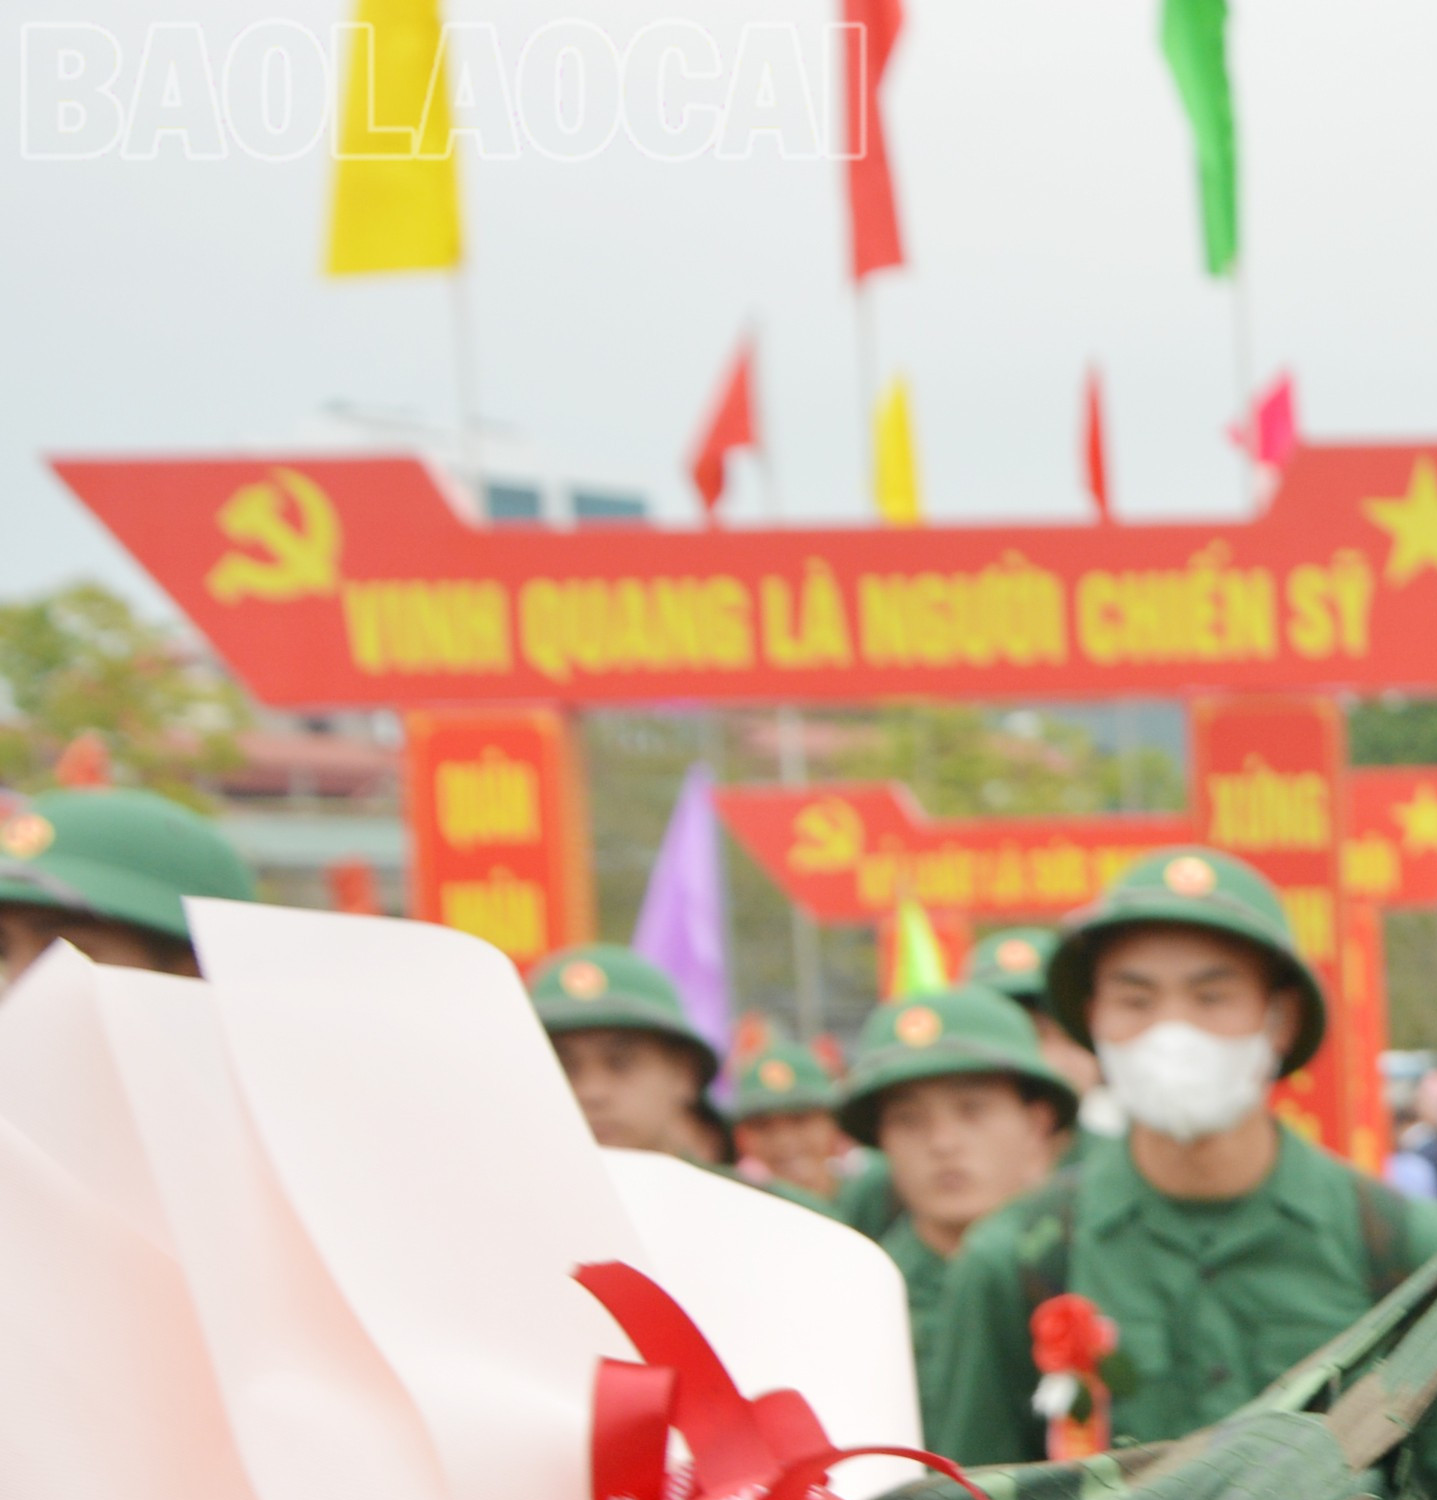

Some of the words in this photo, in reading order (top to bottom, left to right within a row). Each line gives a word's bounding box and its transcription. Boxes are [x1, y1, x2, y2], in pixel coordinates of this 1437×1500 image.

[342, 577, 511, 675] VINH
[520, 576, 753, 683] QUANG
[761, 557, 852, 669] LÀ
[858, 549, 1066, 667] NGƯỜI
[1076, 540, 1278, 664] CHIẾN
